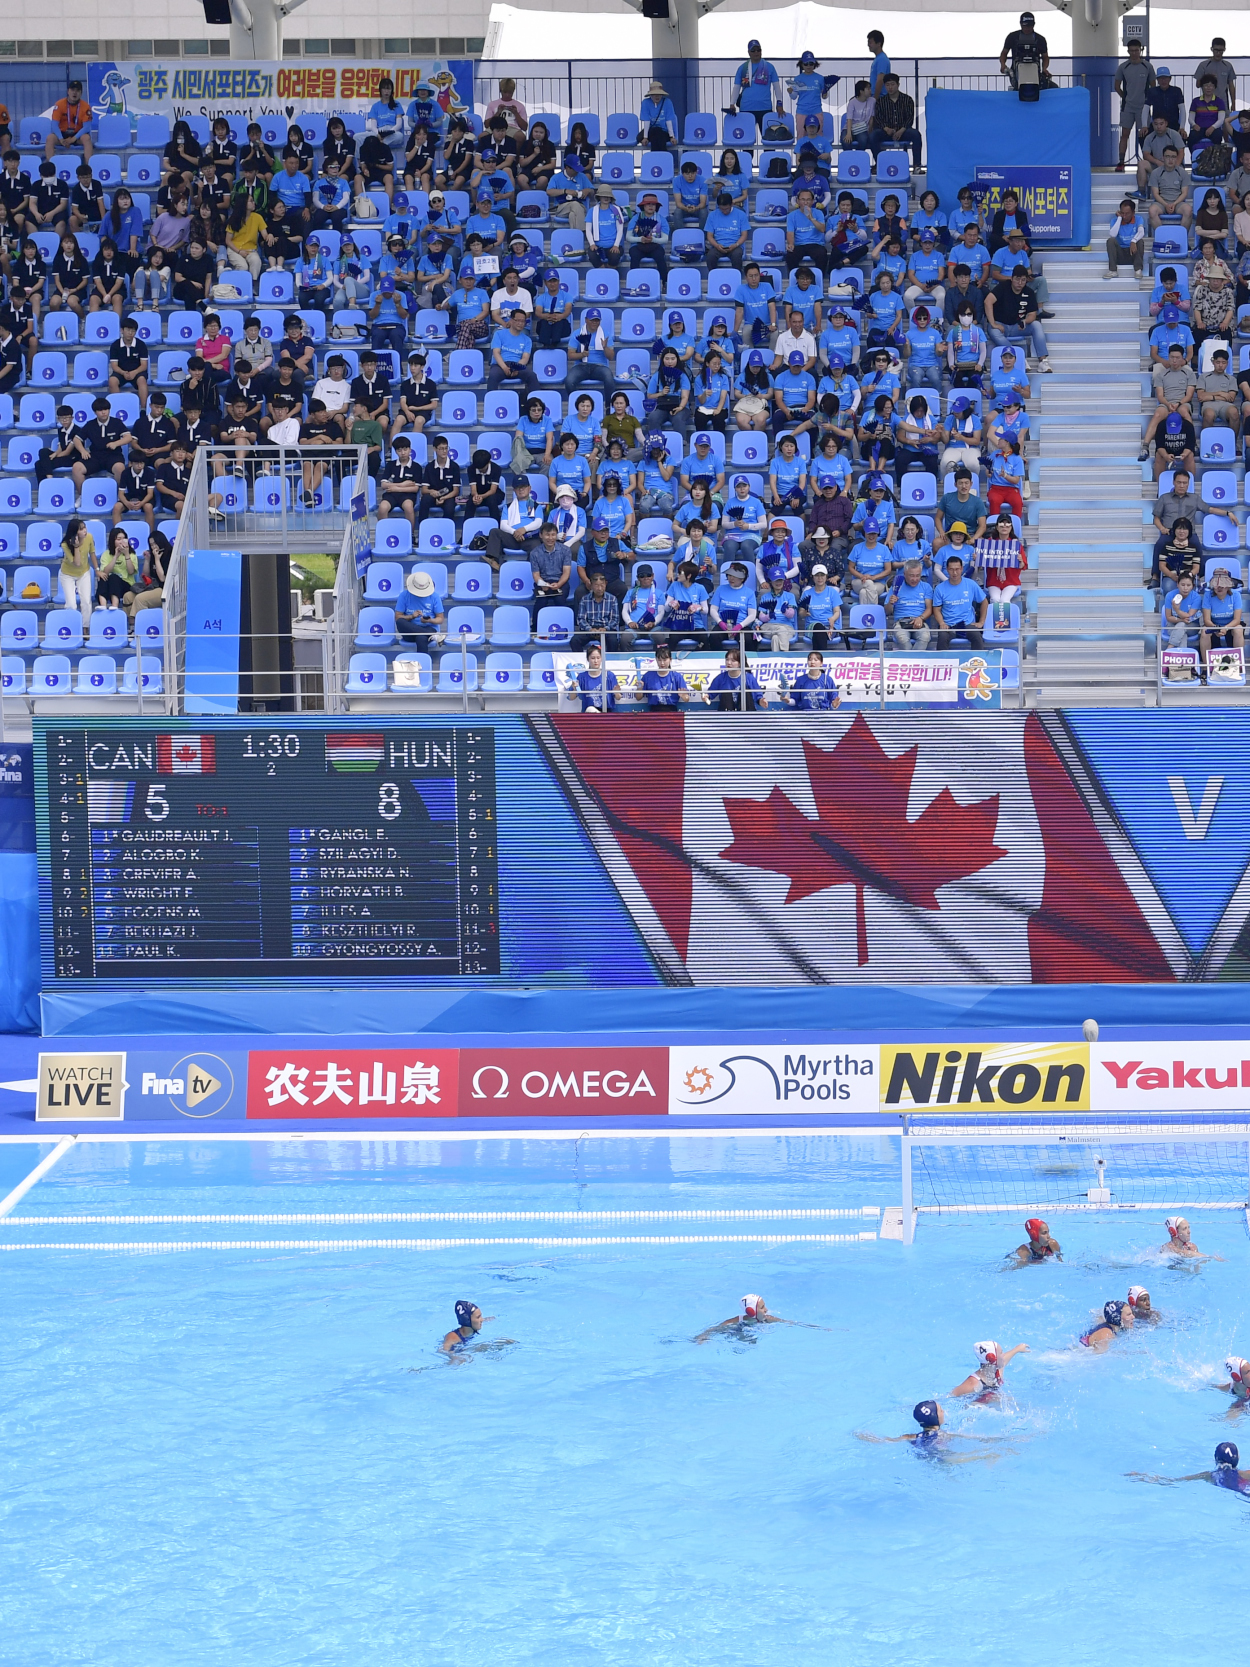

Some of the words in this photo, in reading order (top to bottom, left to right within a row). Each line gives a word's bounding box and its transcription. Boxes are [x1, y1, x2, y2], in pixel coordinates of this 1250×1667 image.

[137, 70, 168, 99] 광주
[172, 69, 273, 99] 시민서포터즈가
[277, 68, 336, 98] 여러분을
[200, 106, 253, 121] Support
[1028, 224, 1060, 233] Supporters
[204, 618, 222, 631] A석
[1164, 656, 1194, 664] PHOTO
[834, 662, 882, 682] 여러분을
[886, 662, 952, 682] 응원합니다!
[864, 684, 895, 696] You
[242, 734, 300, 758] 1:30
[88, 743, 152, 770] CAN
[390, 741, 452, 768] HUN
[266, 762, 276, 776] 2
[144, 784, 170, 822] 5
[378, 782, 402, 820] 8
[1166, 776, 1225, 840] V
[122, 830, 220, 842] GAUDREAULT
[318, 828, 374, 840] GANGL
[122, 849, 186, 861] ALOGBO
[319, 848, 384, 860] SZILAGYI
[122, 888, 182, 899] WRIGHT
[320, 886, 391, 898] HORVATH
[125, 945, 164, 958] PAUL
[322, 942, 423, 957] GYONGYOSSY
[48, 1066, 114, 1082] WATCH
[784, 1054, 874, 1080] Myrtha
[142, 1072, 184, 1095] Fina
[192, 1075, 212, 1094] tv
[264, 1061, 442, 1107] 农夫山泉
[521, 1068, 657, 1098] OMEGA
[884, 1050, 1086, 1104] Nikon
[48, 1082, 112, 1106] LIVE
[784, 1078, 852, 1101] Pools
[456, 1304, 465, 1314] 2
[1106, 1303, 1117, 1314] 10
[980, 1346, 987, 1354] 4
[1226, 1362, 1232, 1372] 5
[922, 1406, 930, 1416] 5
